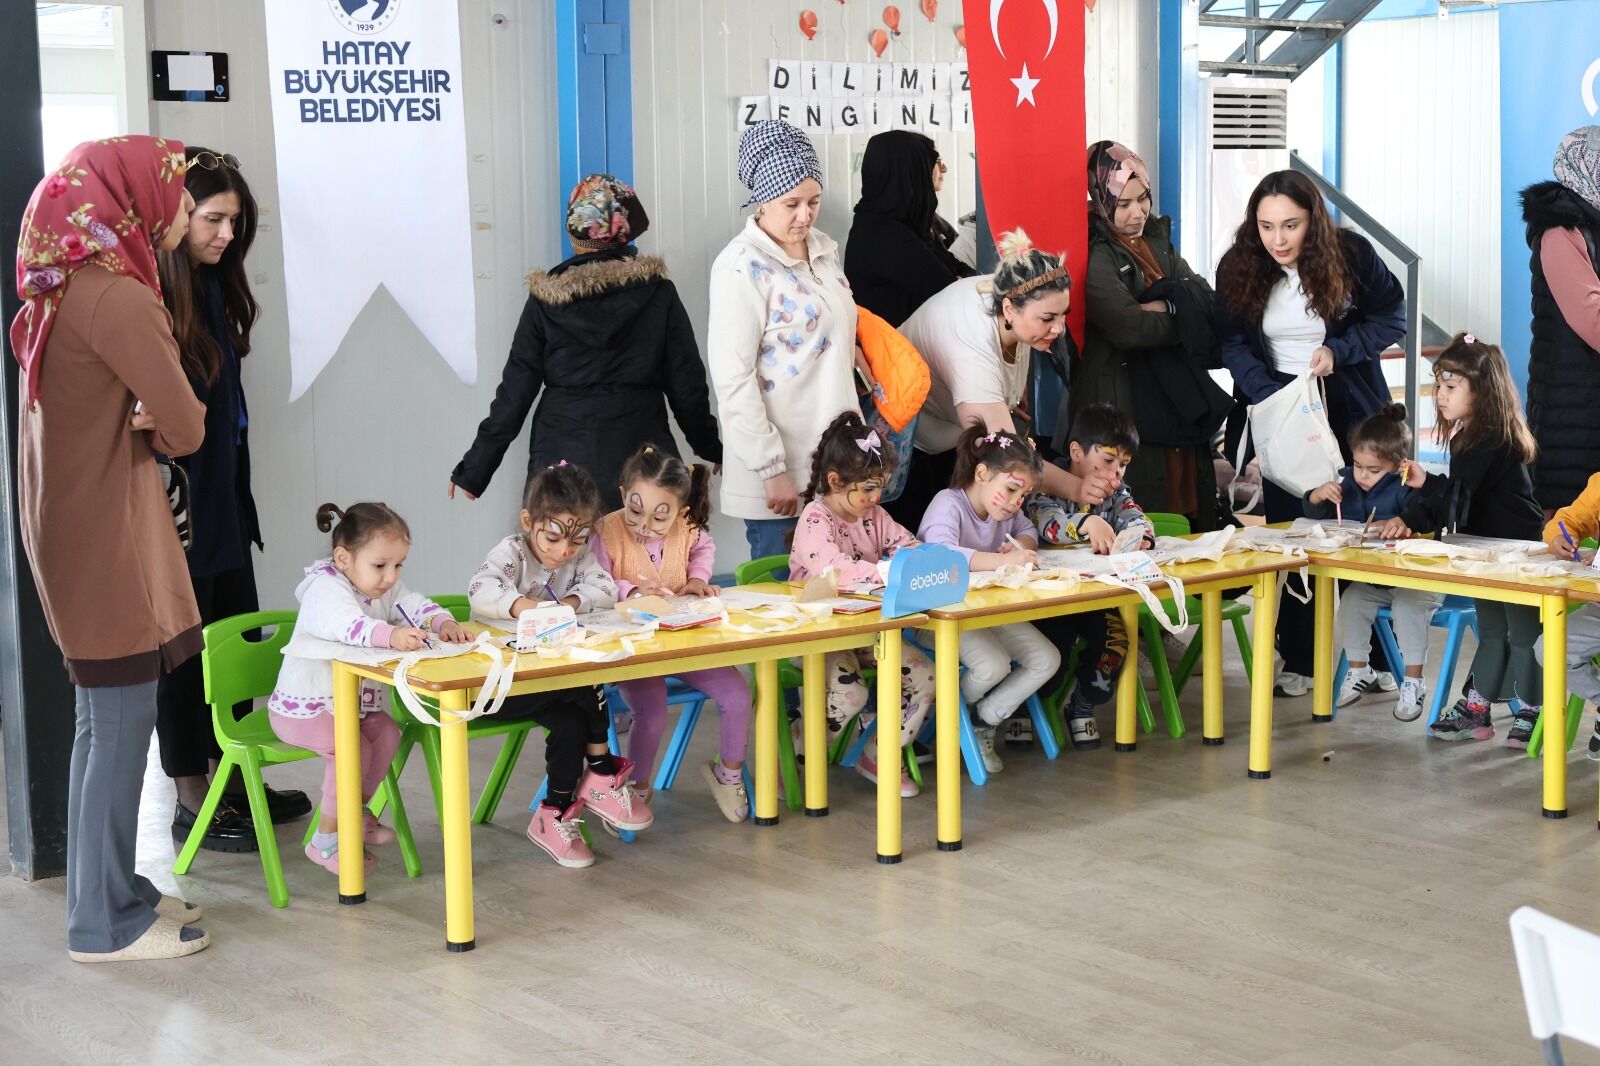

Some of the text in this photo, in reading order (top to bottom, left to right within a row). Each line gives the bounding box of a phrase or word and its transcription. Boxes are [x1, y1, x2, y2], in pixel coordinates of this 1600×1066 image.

[322, 41, 411, 65] HATAY
[284, 70, 451, 95] BÜYÜKŞEHİR
[300, 98, 441, 123] BELEDİYESİ
[910, 569, 950, 591] ebebek
